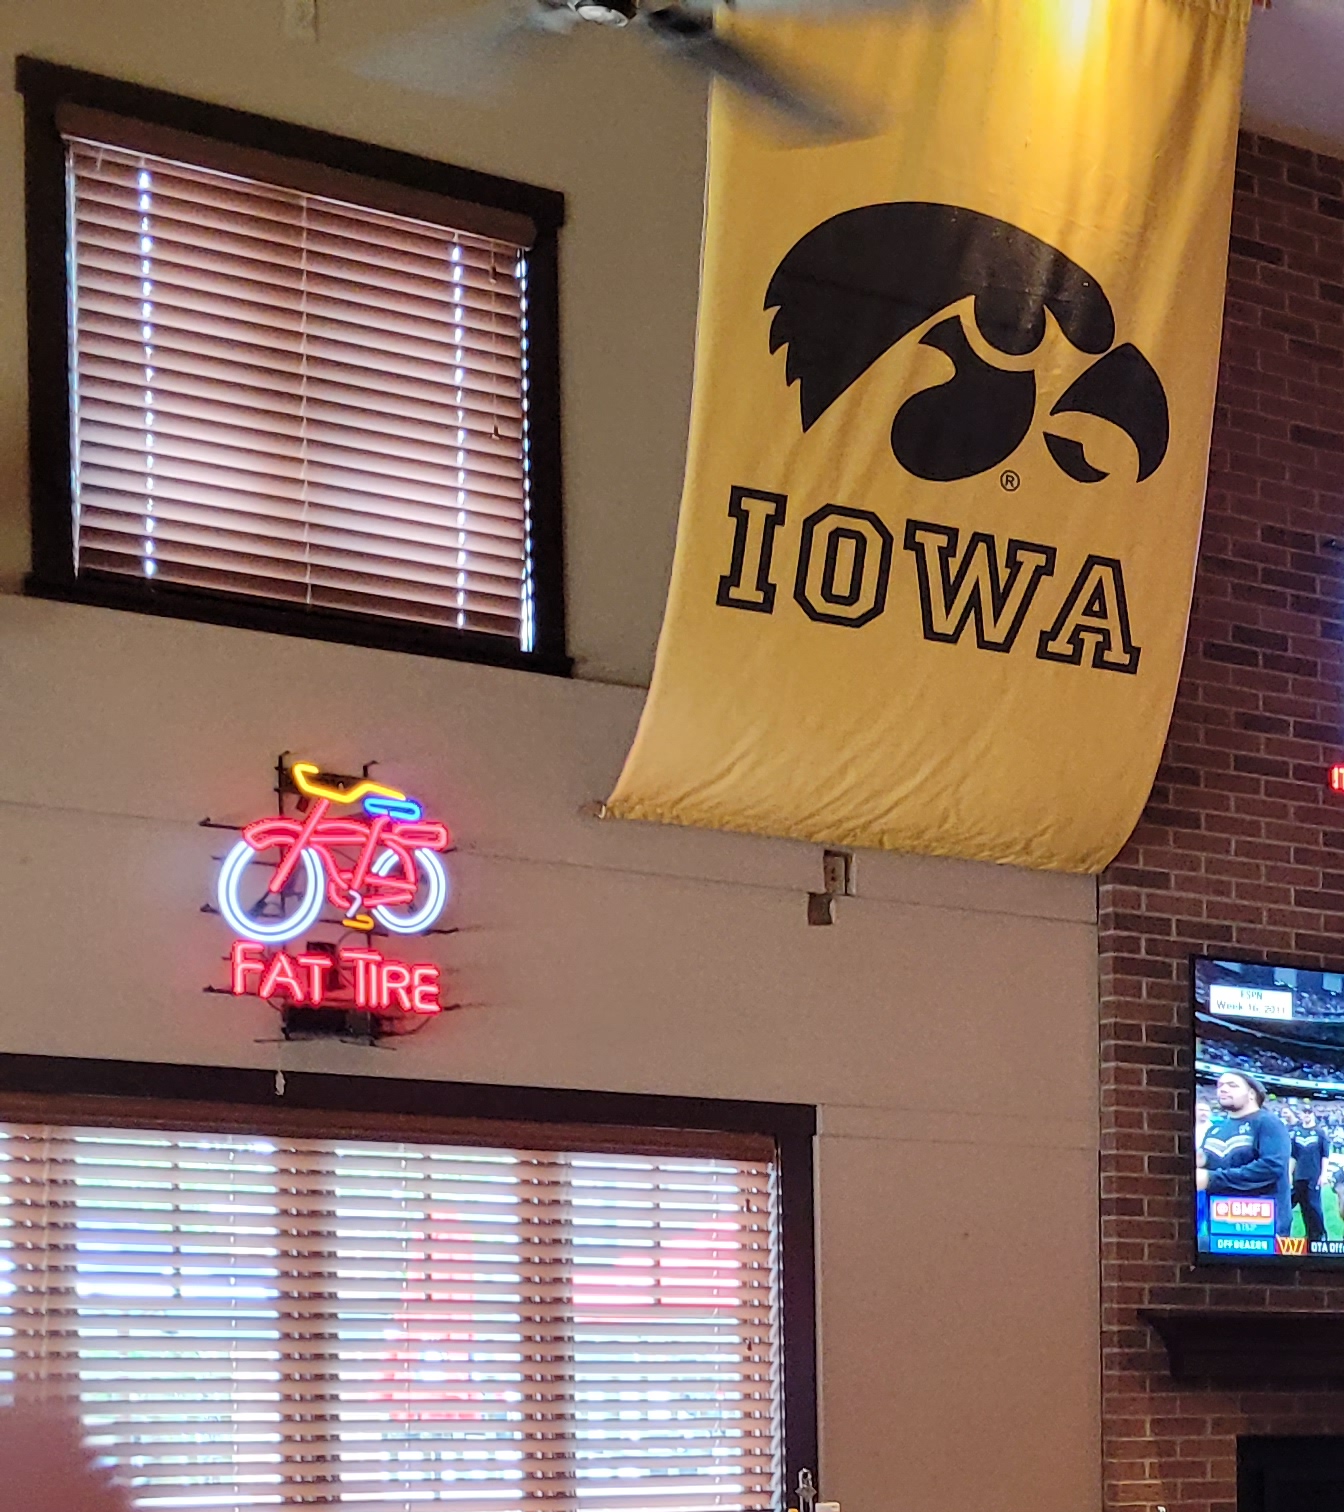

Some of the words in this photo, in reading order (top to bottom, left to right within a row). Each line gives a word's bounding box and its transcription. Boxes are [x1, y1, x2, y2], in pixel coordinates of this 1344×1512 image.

[716, 484, 1142, 676] IOWA
[232, 940, 333, 1006] FAT
[338, 948, 442, 1016] TIRE
[1240, 989, 1263, 1001] ESPN
[1216, 999, 1243, 1011] Week
[1310, 1241, 1328, 1253] OTA
